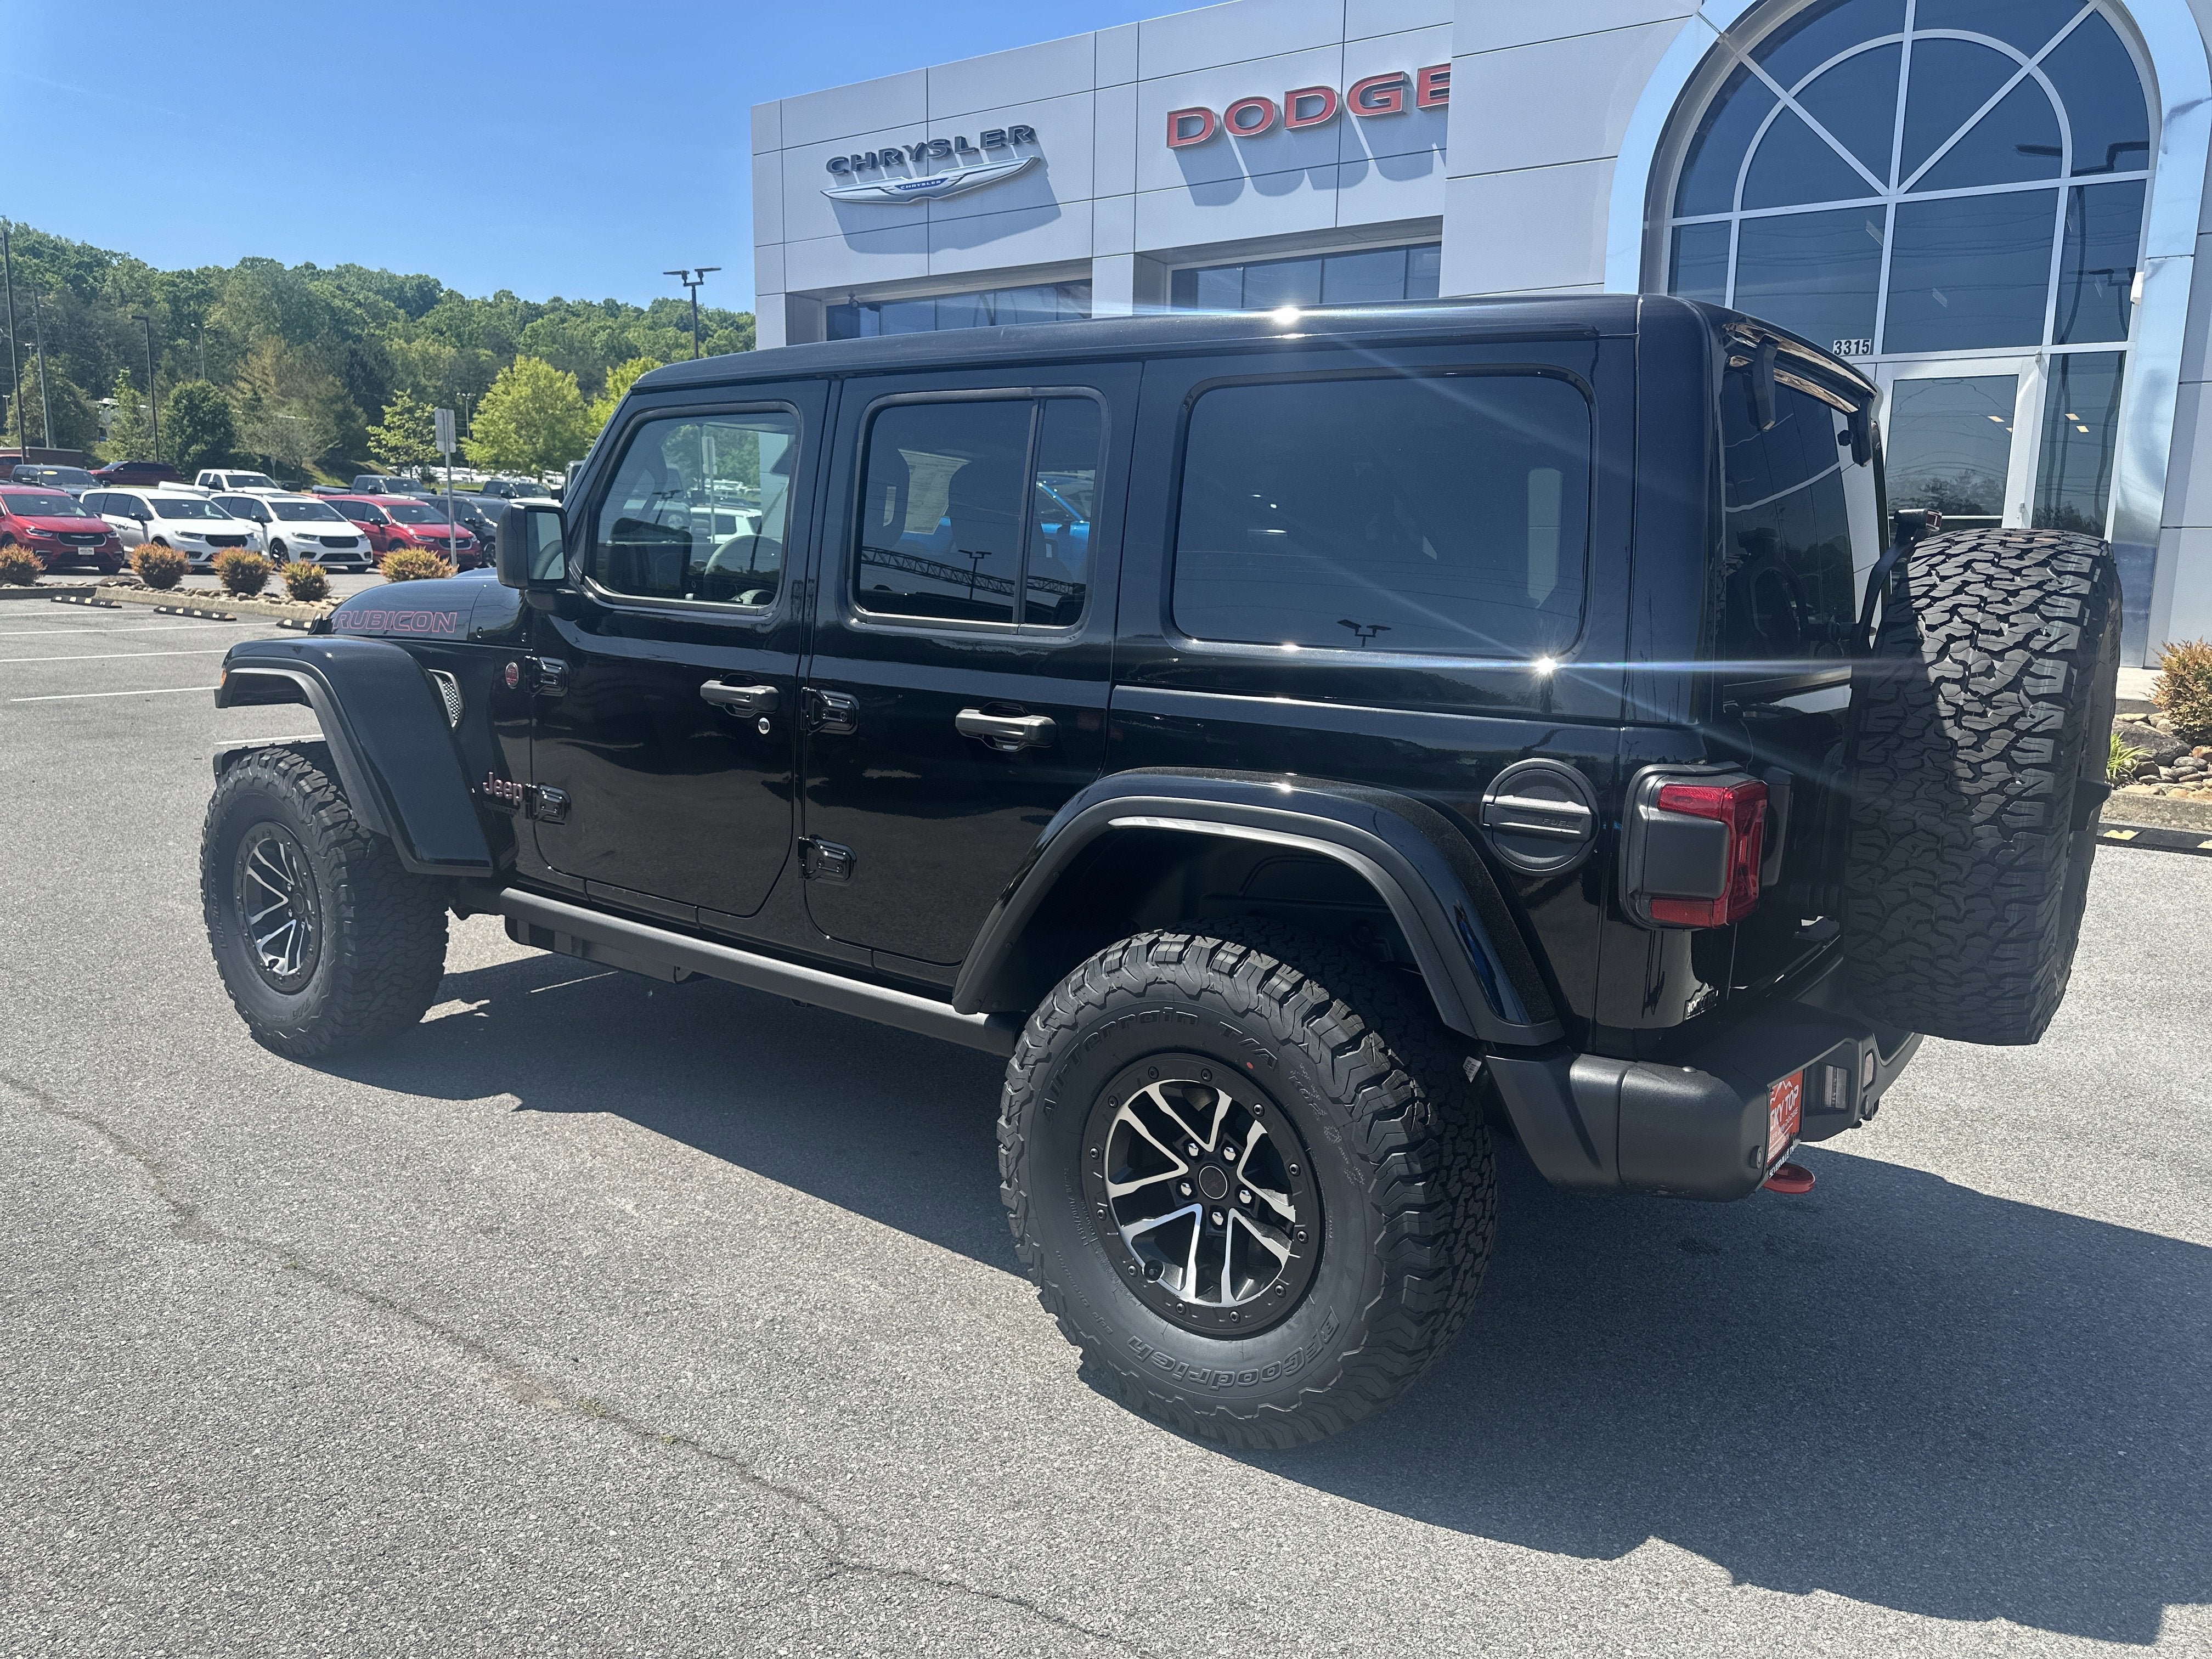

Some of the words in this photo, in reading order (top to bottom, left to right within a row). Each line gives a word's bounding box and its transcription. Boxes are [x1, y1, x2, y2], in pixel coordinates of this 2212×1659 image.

[826, 125, 1037, 174] CHRYSLER
[900, 180, 941, 190] CHRYSLER
[1834, 340, 1870, 356] 3315
[332, 610, 458, 633] RUBICON
[483, 771, 524, 805] Jeep
[1542, 818, 1573, 827] FUEL
[1785, 1084, 1799, 1116] TOP
[1127, 1306, 1340, 1391] BFGoodrich
